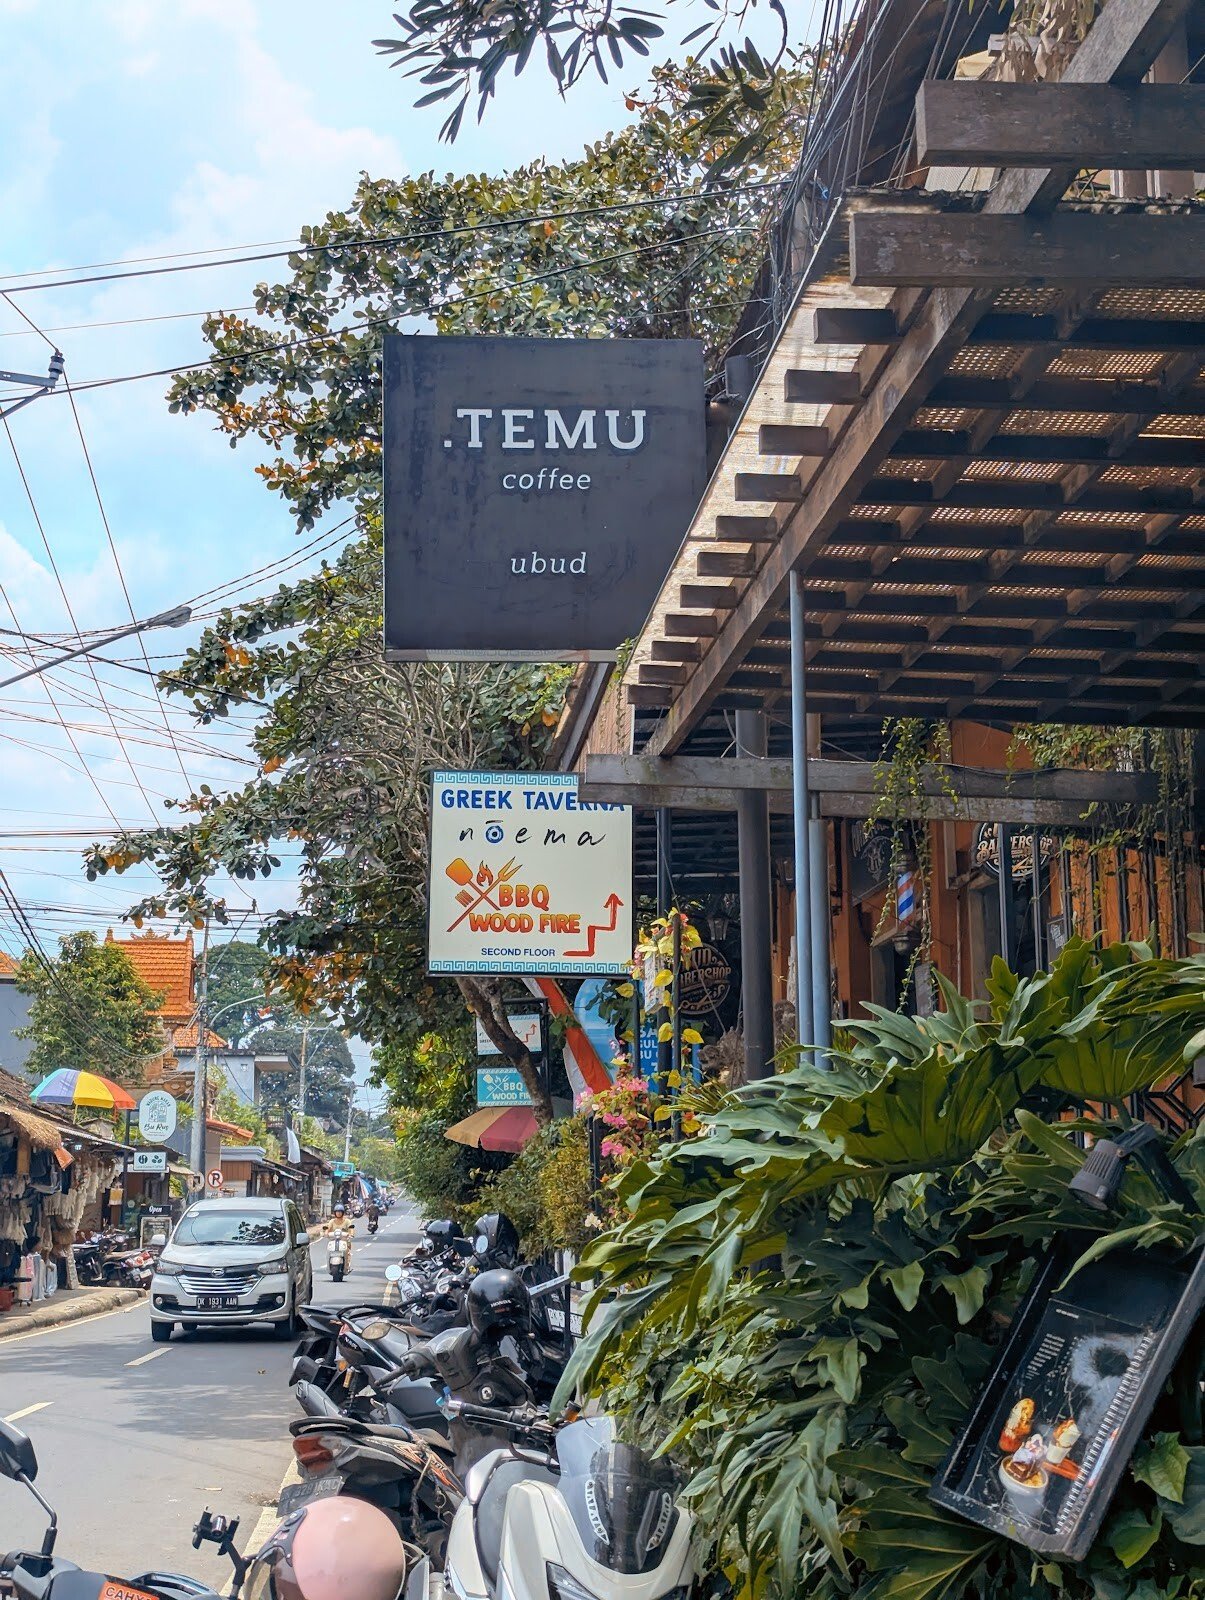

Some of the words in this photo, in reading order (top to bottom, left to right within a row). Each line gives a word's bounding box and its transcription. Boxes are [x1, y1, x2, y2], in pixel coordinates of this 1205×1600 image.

[502, 467, 592, 490] coffee
[510, 551, 588, 574] ubud
[441, 789, 512, 810] GREEK
[499, 884, 550, 911] BBQ
[468, 912, 534, 933] WOOD
[539, 913, 581, 933] FIRE
[481, 947, 521, 956] SECOND
[523, 948, 556, 957] FLOOR
[503, 1082, 523, 1092] BBQ
[492, 1092, 517, 1100] WOOD
[148, 1205, 162, 1214] Open
[197, 1297, 205, 1305] DK
